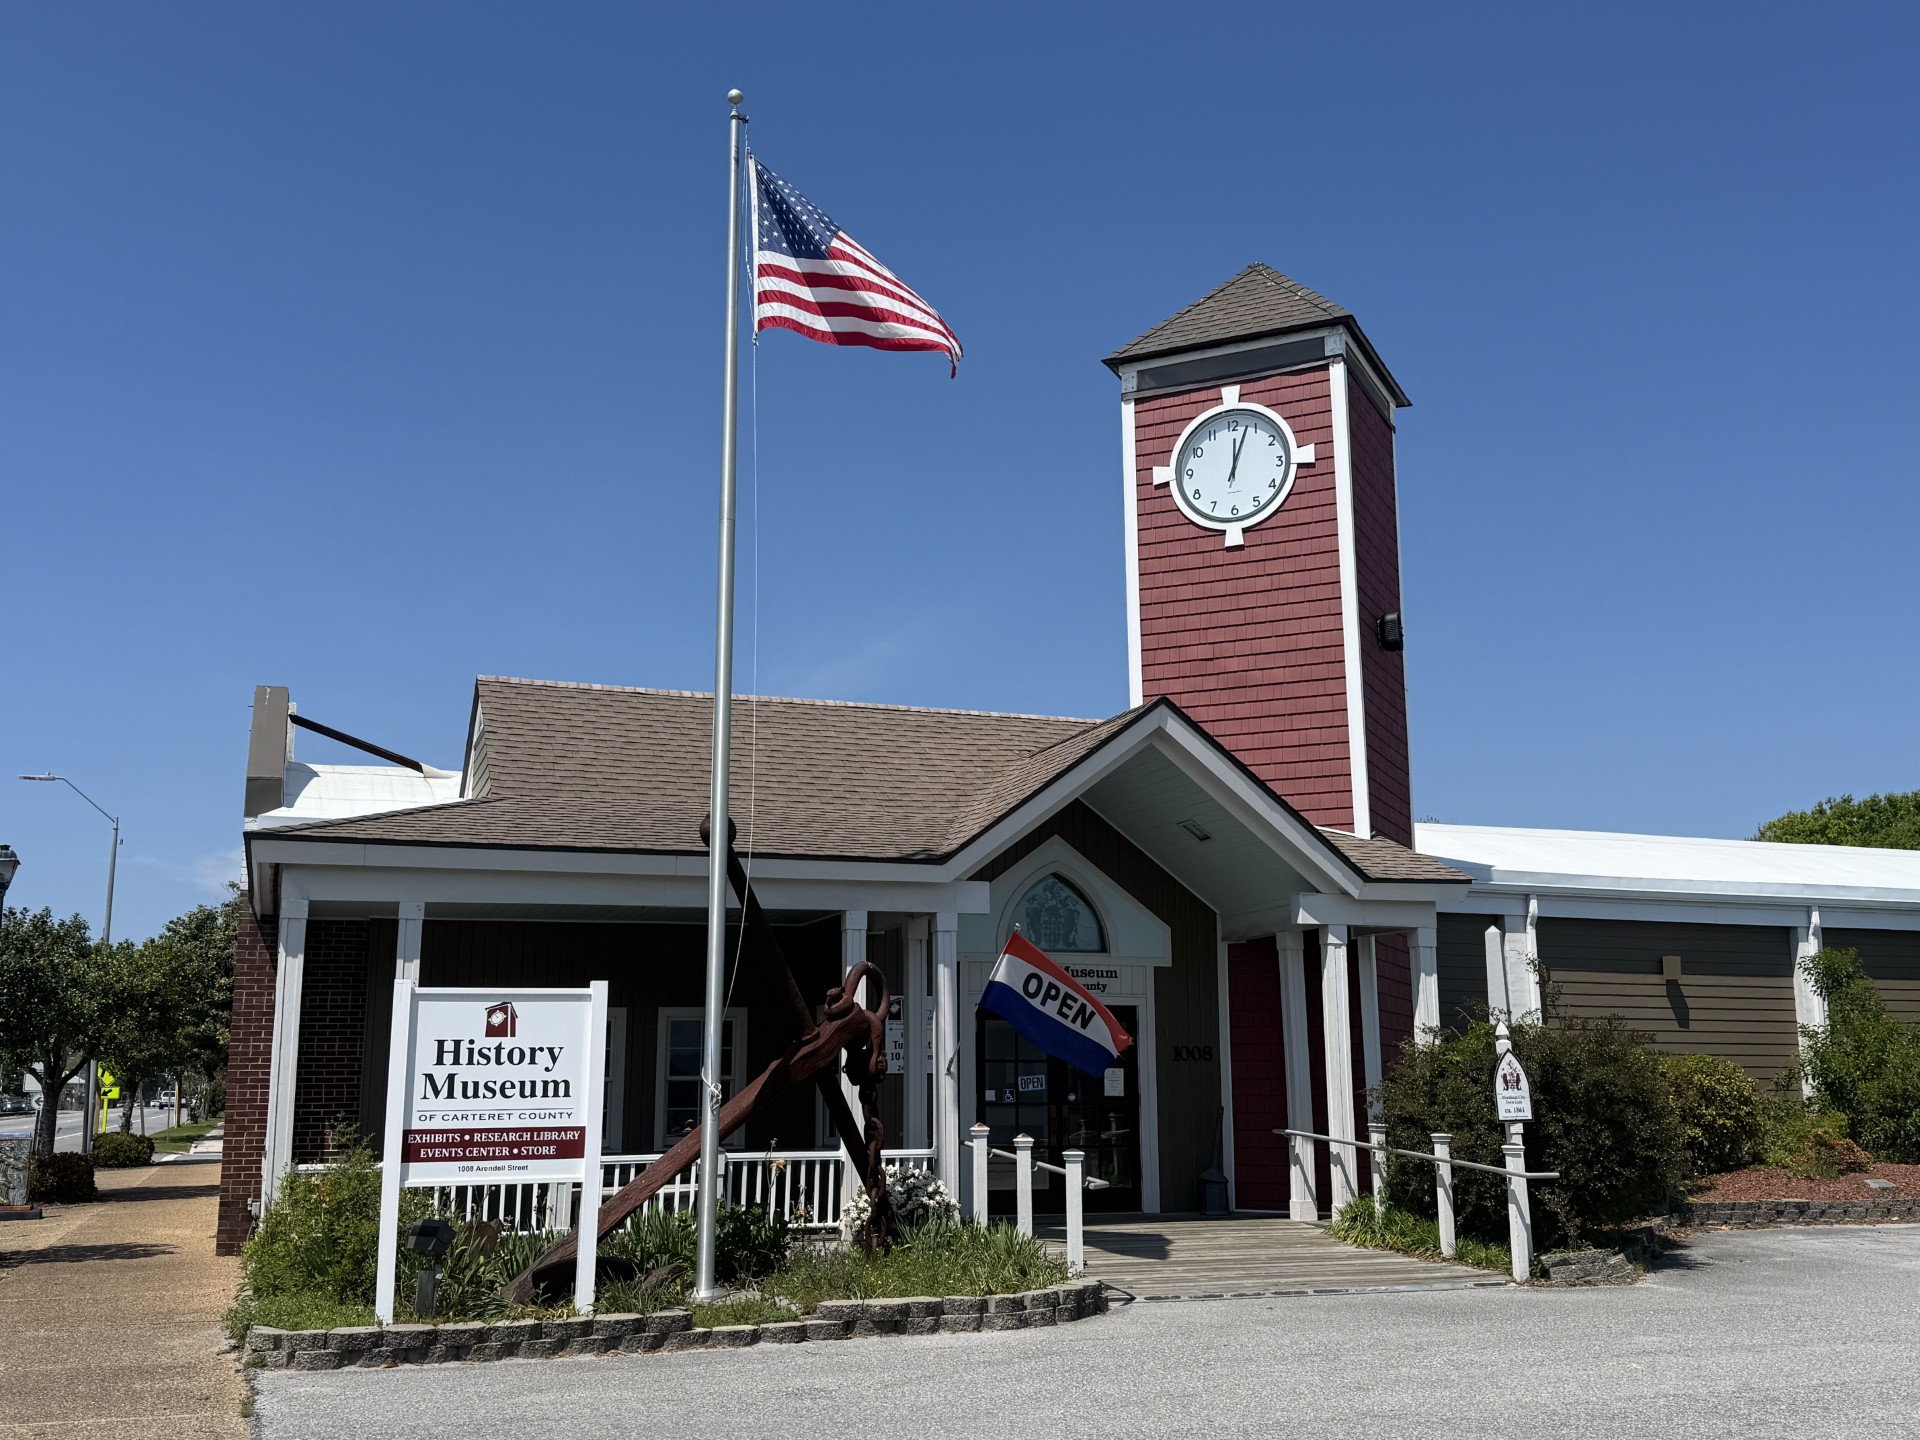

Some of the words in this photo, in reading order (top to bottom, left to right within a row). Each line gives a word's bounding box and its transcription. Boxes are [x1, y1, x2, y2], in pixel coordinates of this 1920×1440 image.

[1228, 420, 1238, 432] 12
[1208, 430, 1216, 441] 11
[1268, 435, 1276, 446] 2
[1192, 447, 1204, 459] 10
[1276, 456, 1283, 467] 3
[1186, 469, 1194, 479] 9
[1268, 479, 1276, 489] 4
[1193, 489, 1201, 500] 8
[1210, 501, 1217, 512] 7
[1253, 496, 1260, 508] 5
[1231, 505, 1239, 516] 6
[1082, 982, 1107, 992] unty
[1022, 972, 1097, 1030] OPEN
[432, 1039, 564, 1072] History
[1172, 1046, 1213, 1061] 1008
[420, 1072, 572, 1100] Museum
[1020, 1077, 1044, 1090] OPEN
[442, 1113, 514, 1121] CARTERET
[519, 1112, 573, 1120] COUNTY
[407, 1133, 461, 1143] EXHIBITS
[473, 1132, 531, 1142] RESEARCH
[533, 1131, 581, 1141] LIBRARY
[420, 1148, 463, 1158] EVENTS
[466, 1147, 510, 1157] CENTER
[521, 1146, 557, 1156] STORE
